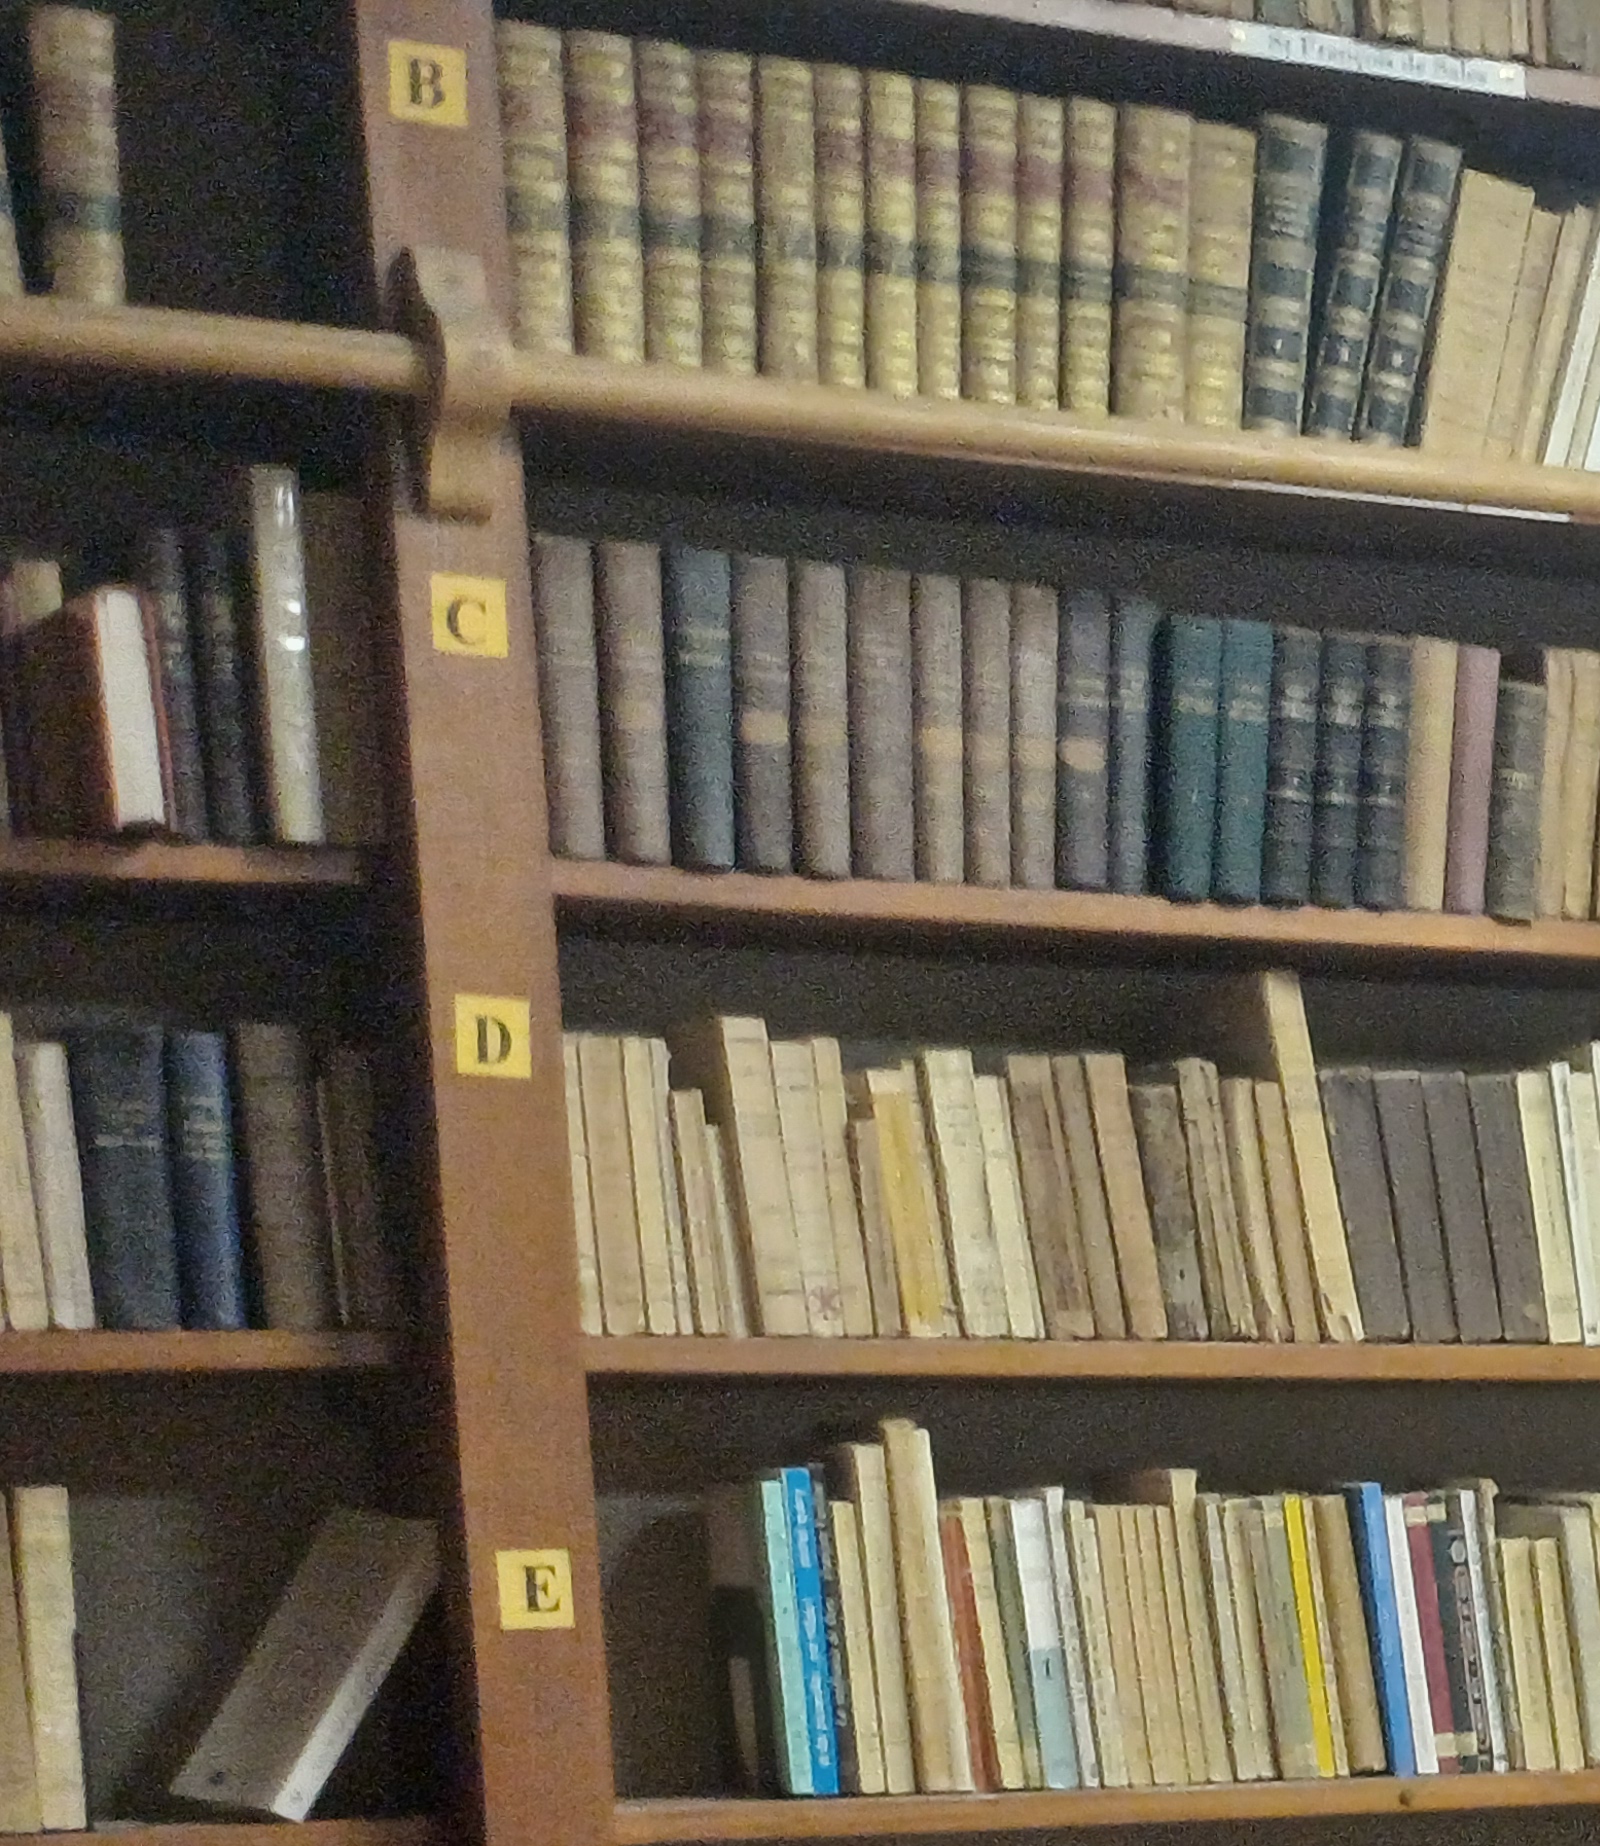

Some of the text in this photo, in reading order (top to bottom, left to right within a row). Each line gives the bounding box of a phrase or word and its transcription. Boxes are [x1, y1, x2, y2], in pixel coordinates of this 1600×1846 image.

[409, 58, 446, 109] B
[446, 597, 487, 646] C
[476, 1014, 512, 1064] D
[524, 1564, 561, 1613] E
